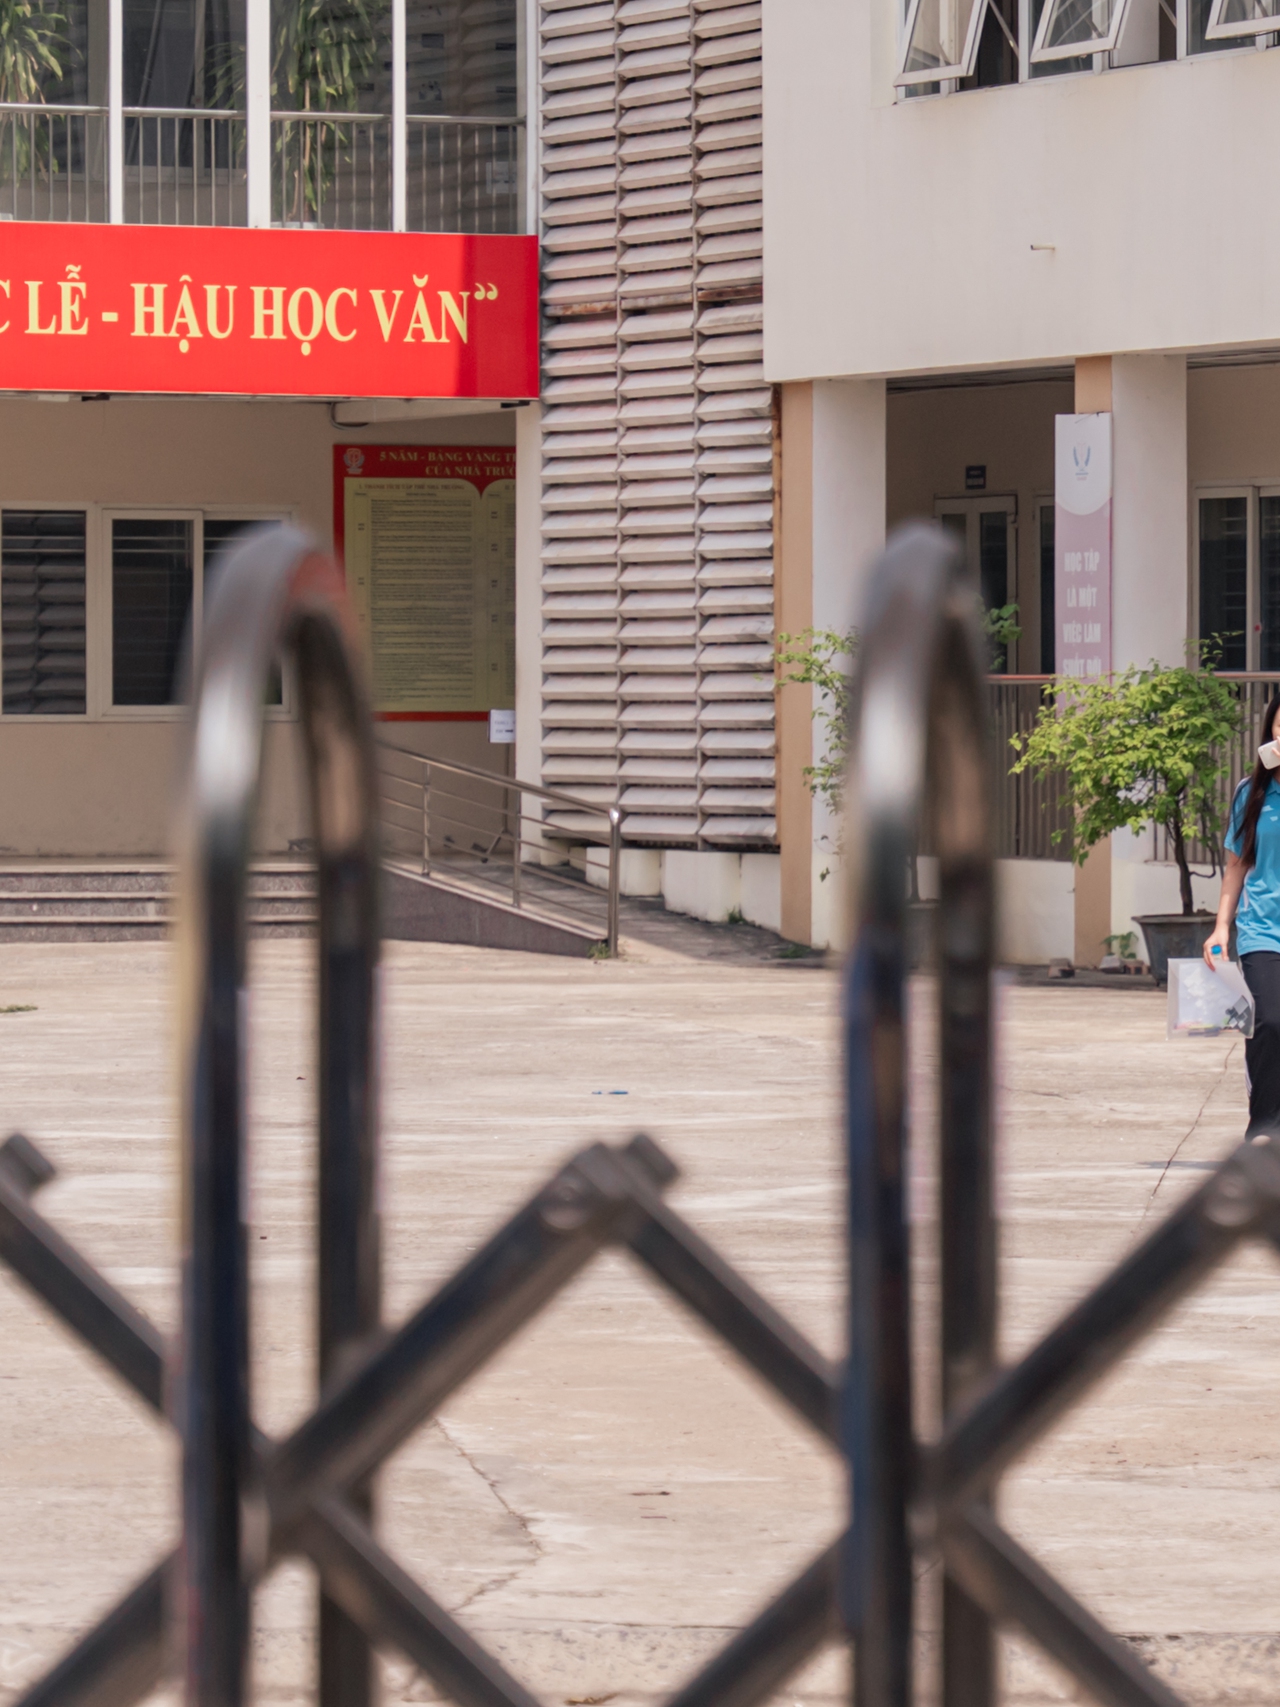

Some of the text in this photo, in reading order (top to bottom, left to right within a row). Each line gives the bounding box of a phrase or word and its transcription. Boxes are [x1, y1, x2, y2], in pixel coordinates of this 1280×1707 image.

[24, 264, 89, 335] LỄ
[101, 311, 119, 323] -
[131, 274, 238, 354] HẬU
[250, 286, 358, 356] HỌC
[379, 451, 386, 462] 5
